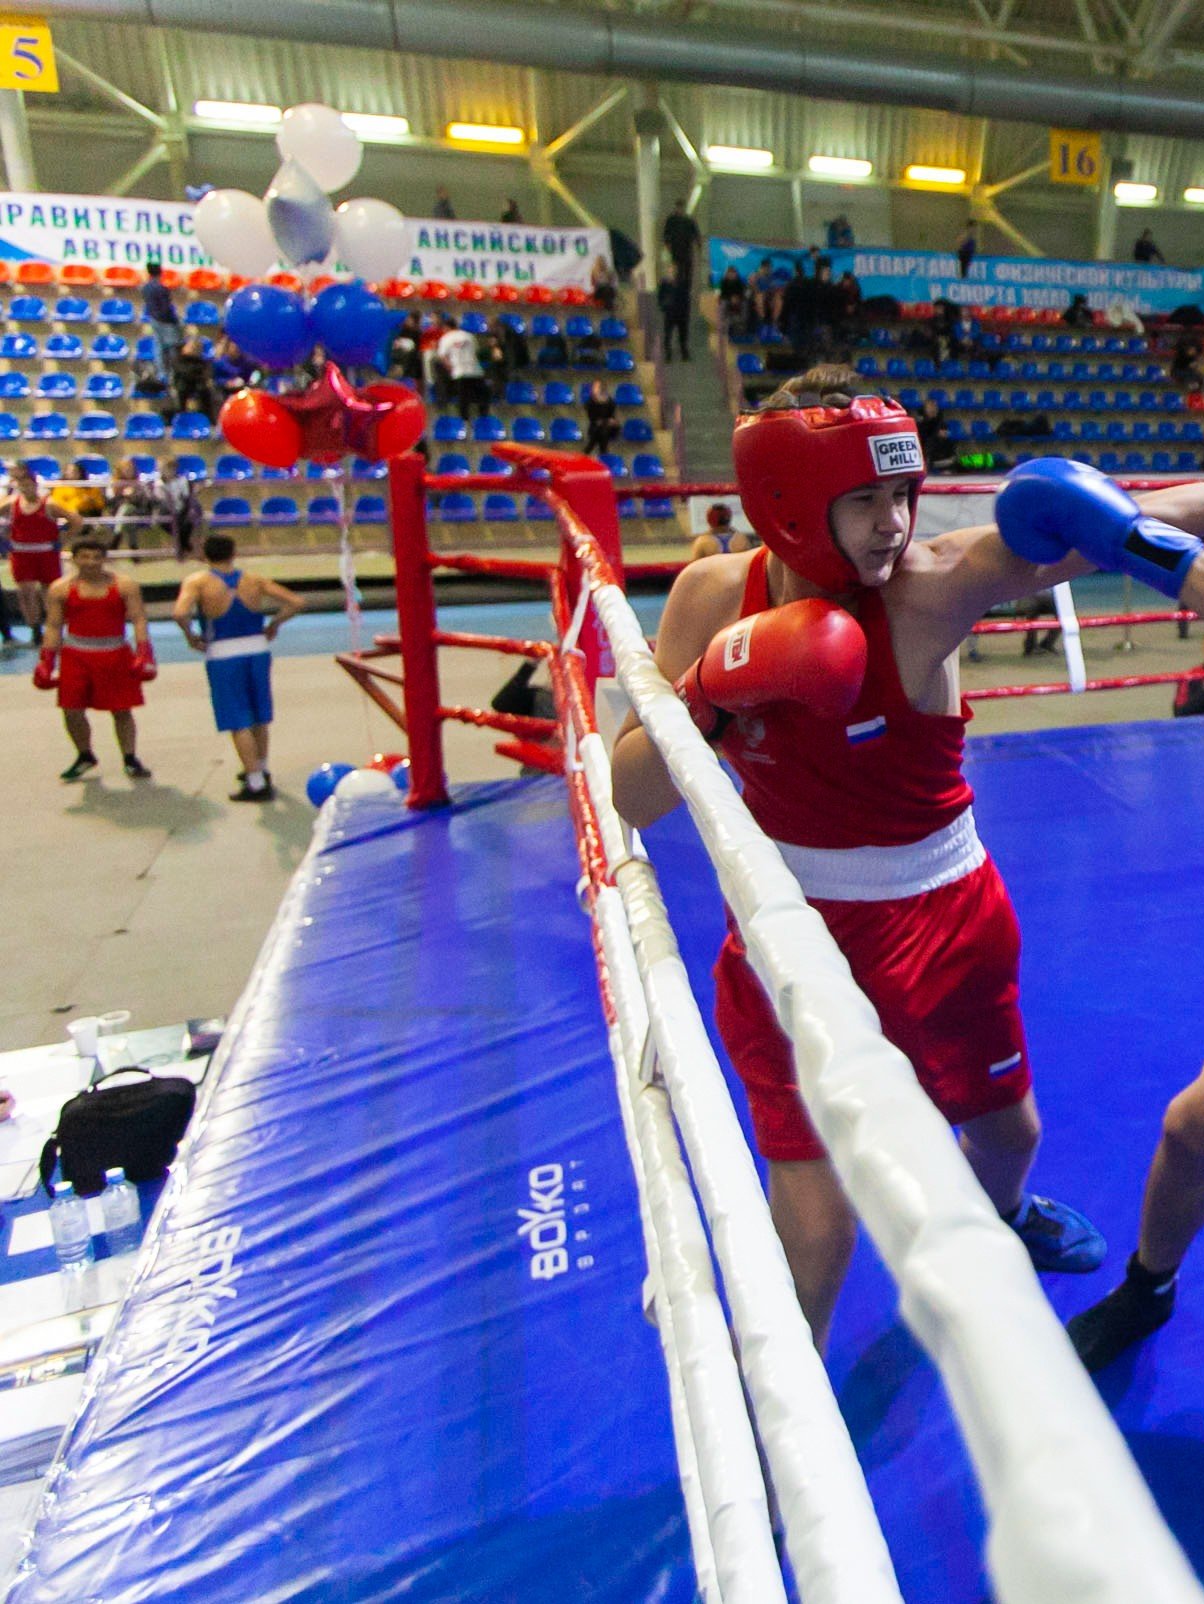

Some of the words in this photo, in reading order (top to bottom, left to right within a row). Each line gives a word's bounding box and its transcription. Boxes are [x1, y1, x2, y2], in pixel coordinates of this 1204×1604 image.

[1060, 143, 1096, 176] 16
[0, 202, 196, 237] РАВИТЕЛЬС
[418, 227, 589, 256] АНСИЙСКОГО
[63, 238, 213, 266] АВТОНОМ
[453, 256, 536, 281] ЮГРЫ
[878, 440, 917, 455] GREEN
[889, 452, 915, 466] HILL
[517, 1163, 568, 1280] BOYKO
